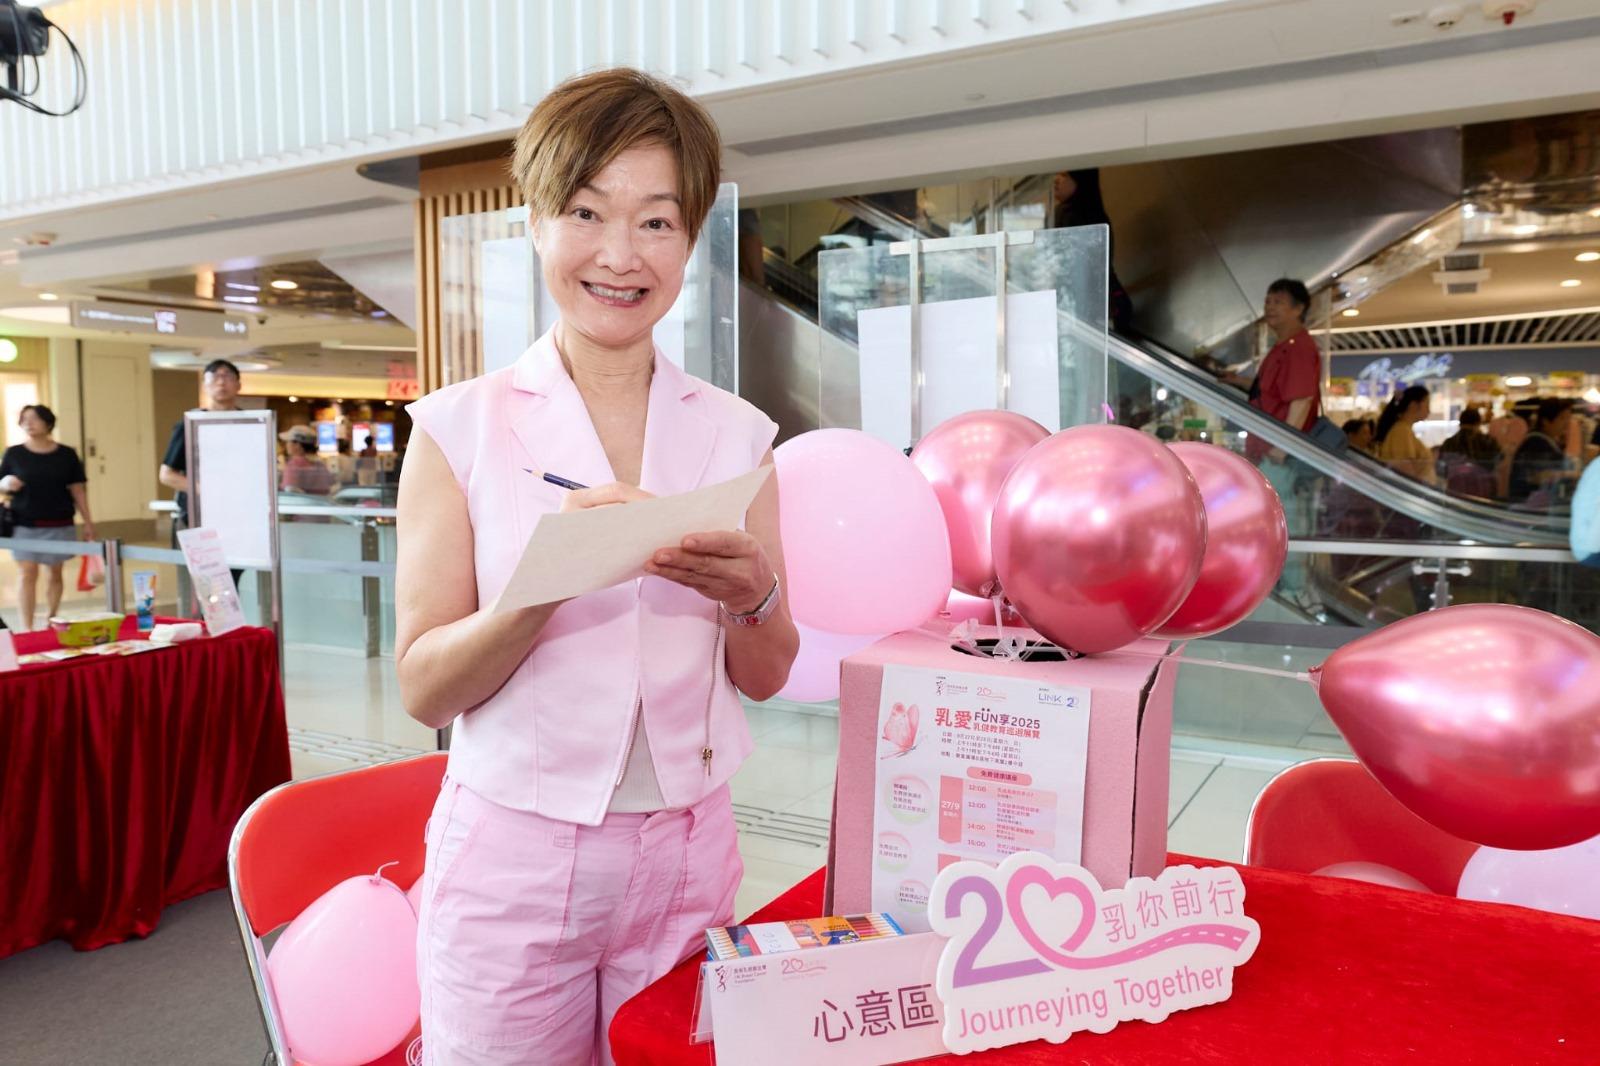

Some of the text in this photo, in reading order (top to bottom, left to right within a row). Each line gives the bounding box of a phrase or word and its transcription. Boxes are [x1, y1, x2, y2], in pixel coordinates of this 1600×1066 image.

[1102, 878, 1237, 943] 乳你前行
[812, 983, 939, 1044] 心意區
[959, 963, 1224, 1038] Journeying Together
